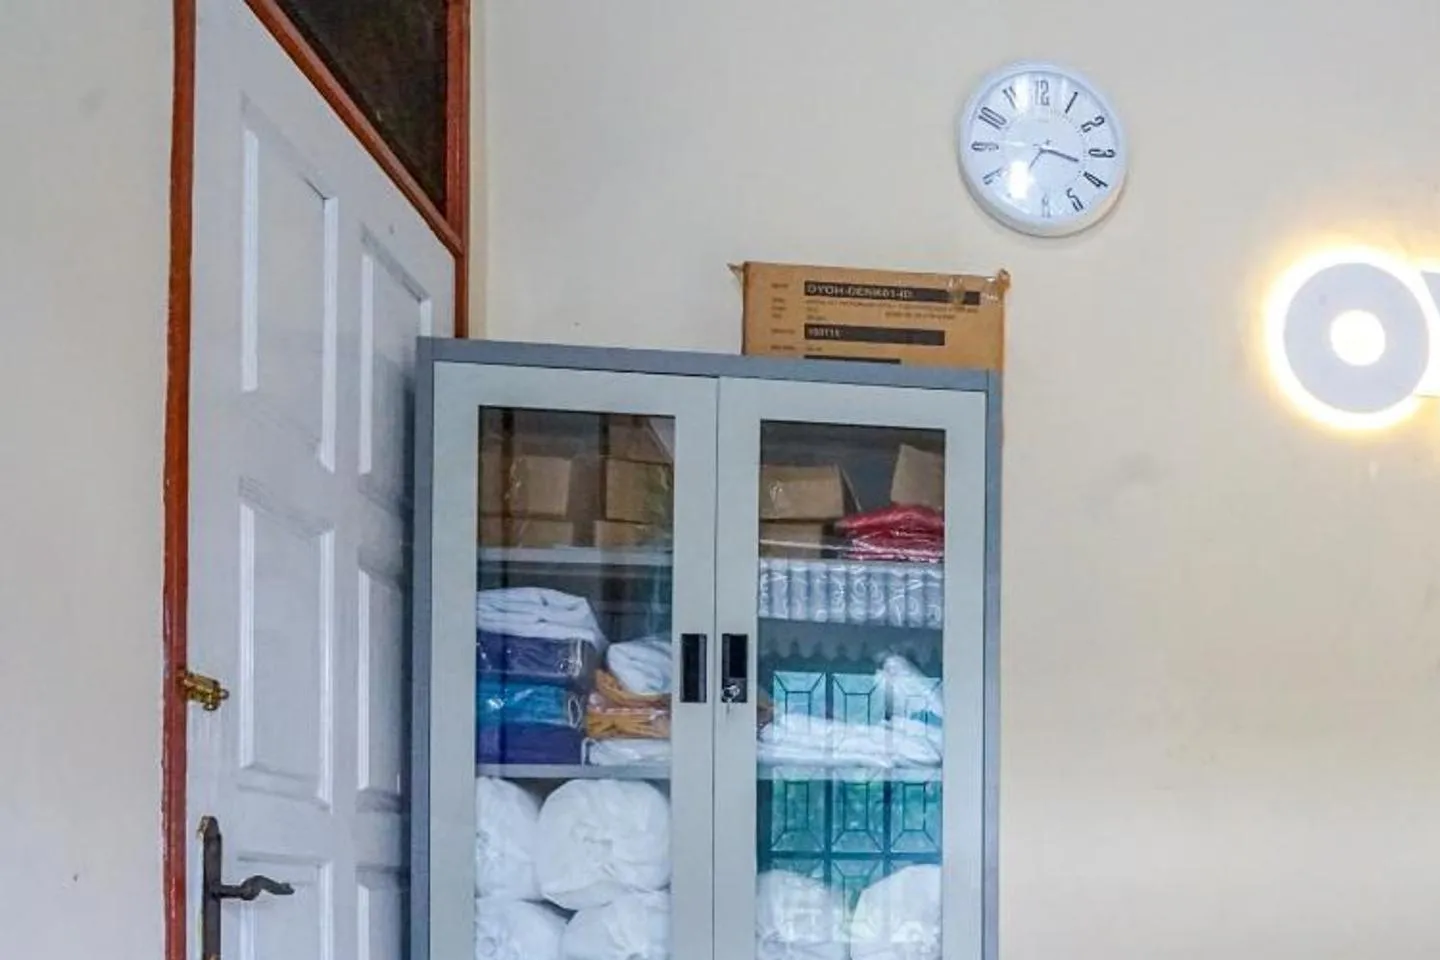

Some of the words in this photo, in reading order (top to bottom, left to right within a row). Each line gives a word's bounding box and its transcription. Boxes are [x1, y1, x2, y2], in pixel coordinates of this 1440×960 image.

[1034, 79, 1050, 106] 12
[1064, 91, 1079, 114] 1
[978, 106, 1007, 130] 10
[1080, 115, 1105, 133] 2
[971, 141, 999, 152] 9
[1088, 148, 1116, 159] 3
[1083, 171, 1108, 188] 4
[1066, 187, 1084, 212] 5
